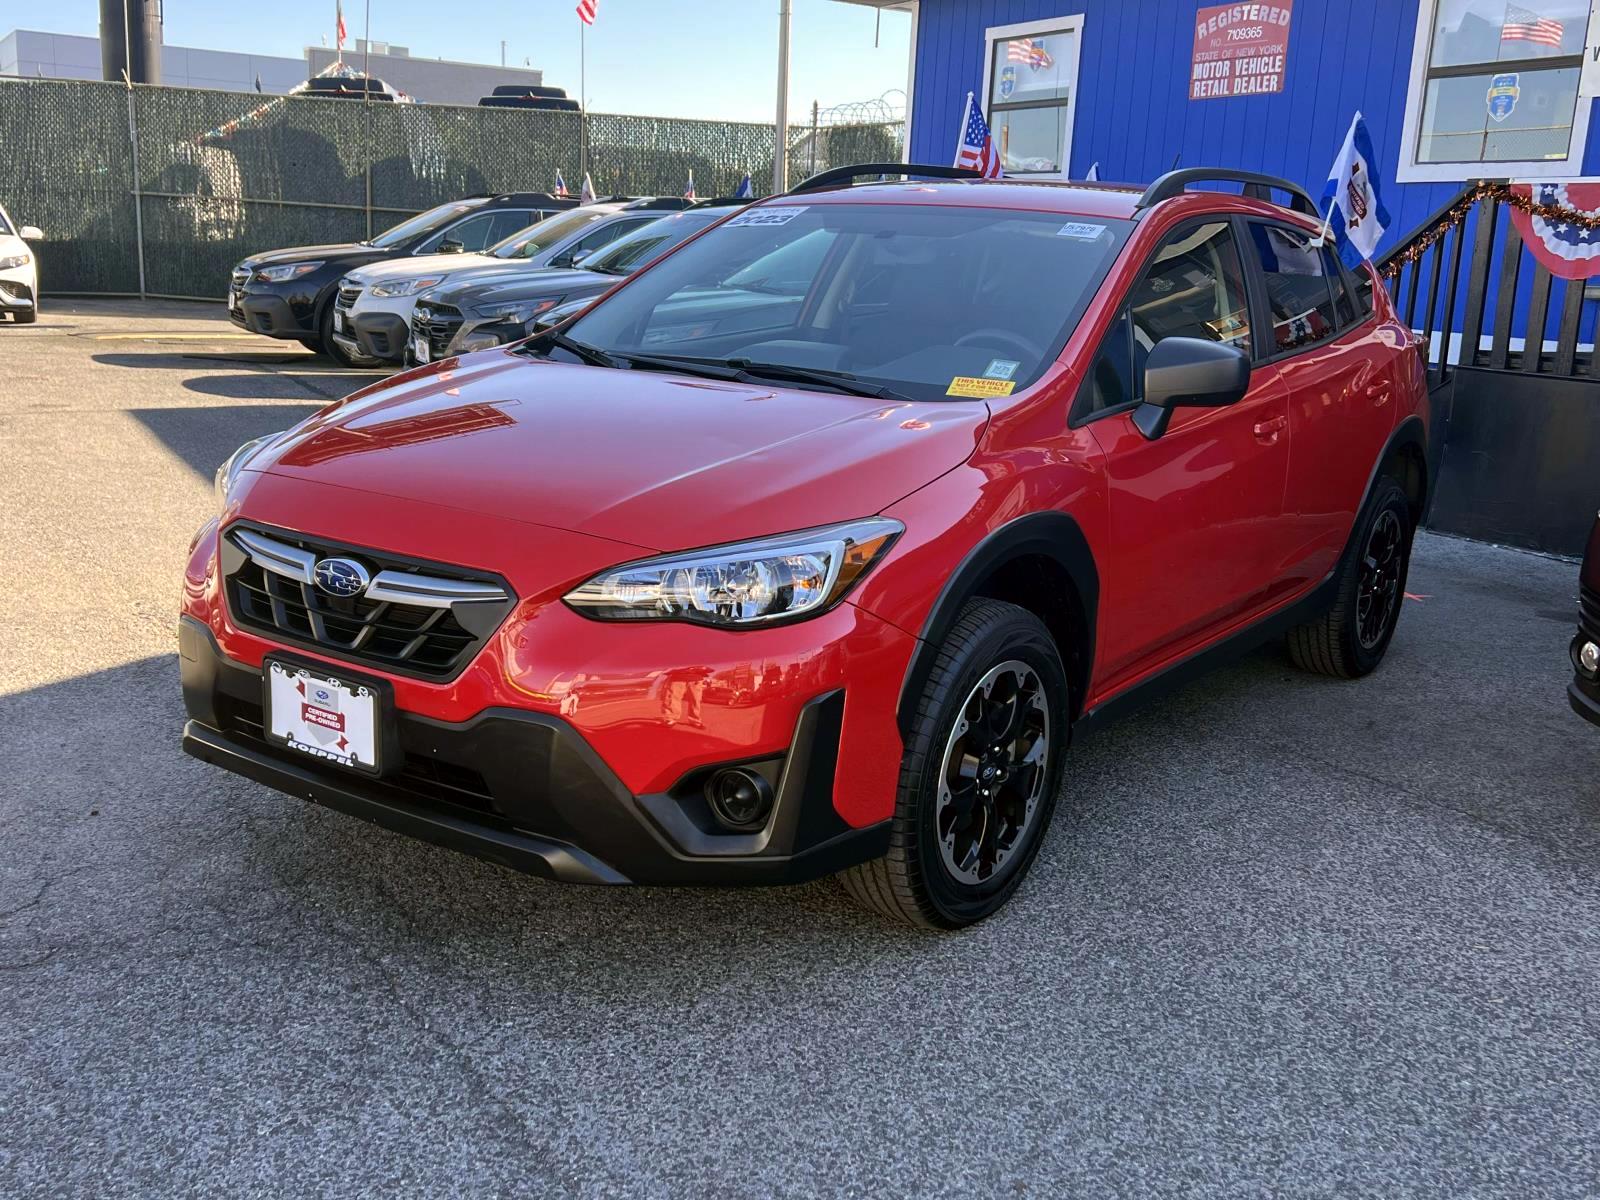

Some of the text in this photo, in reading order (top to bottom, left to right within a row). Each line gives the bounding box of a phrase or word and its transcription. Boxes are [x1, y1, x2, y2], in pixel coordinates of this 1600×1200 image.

[1197, 4, 1290, 40] REGISTERED
[1227, 26, 1263, 41] 7109365
[1195, 44, 1284, 62] STATE OF NEW YORK
[1193, 55, 1284, 80] MOTOR VEHICLE
[1193, 74, 1279, 98] RETAIL DEALER
[976, 379, 1010, 388] VEHICLE
[304, 712, 341, 729] PRE-OWNED
[307, 706, 338, 721] CERTIFIED
[287, 740, 354, 767] KOEPPEL
